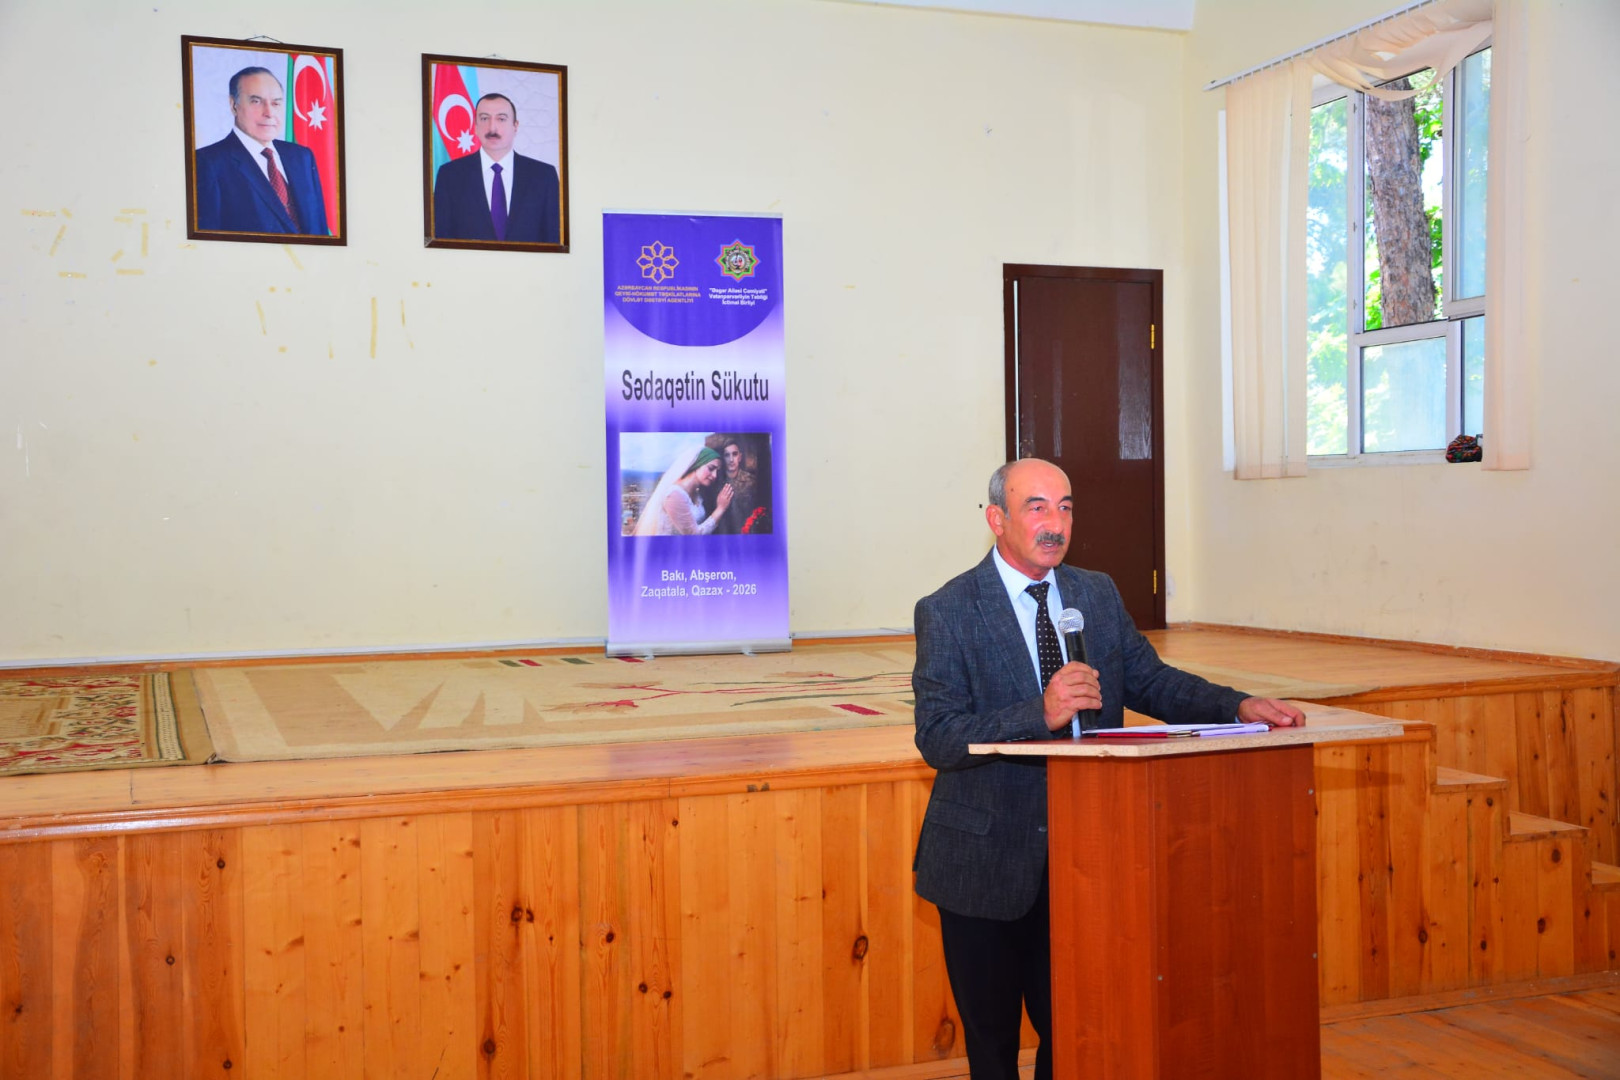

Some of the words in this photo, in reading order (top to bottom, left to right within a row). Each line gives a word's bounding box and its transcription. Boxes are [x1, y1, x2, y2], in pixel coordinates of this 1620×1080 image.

[622, 369, 706, 408] Sədaqətin
[711, 370, 769, 401] Sükutu
[661, 570, 688, 583] Bakı,
[689, 569, 737, 583] Abşeron,
[641, 585, 689, 599] Zaqatala,
[691, 585, 724, 596] Qazax
[732, 584, 757, 595] 2026
